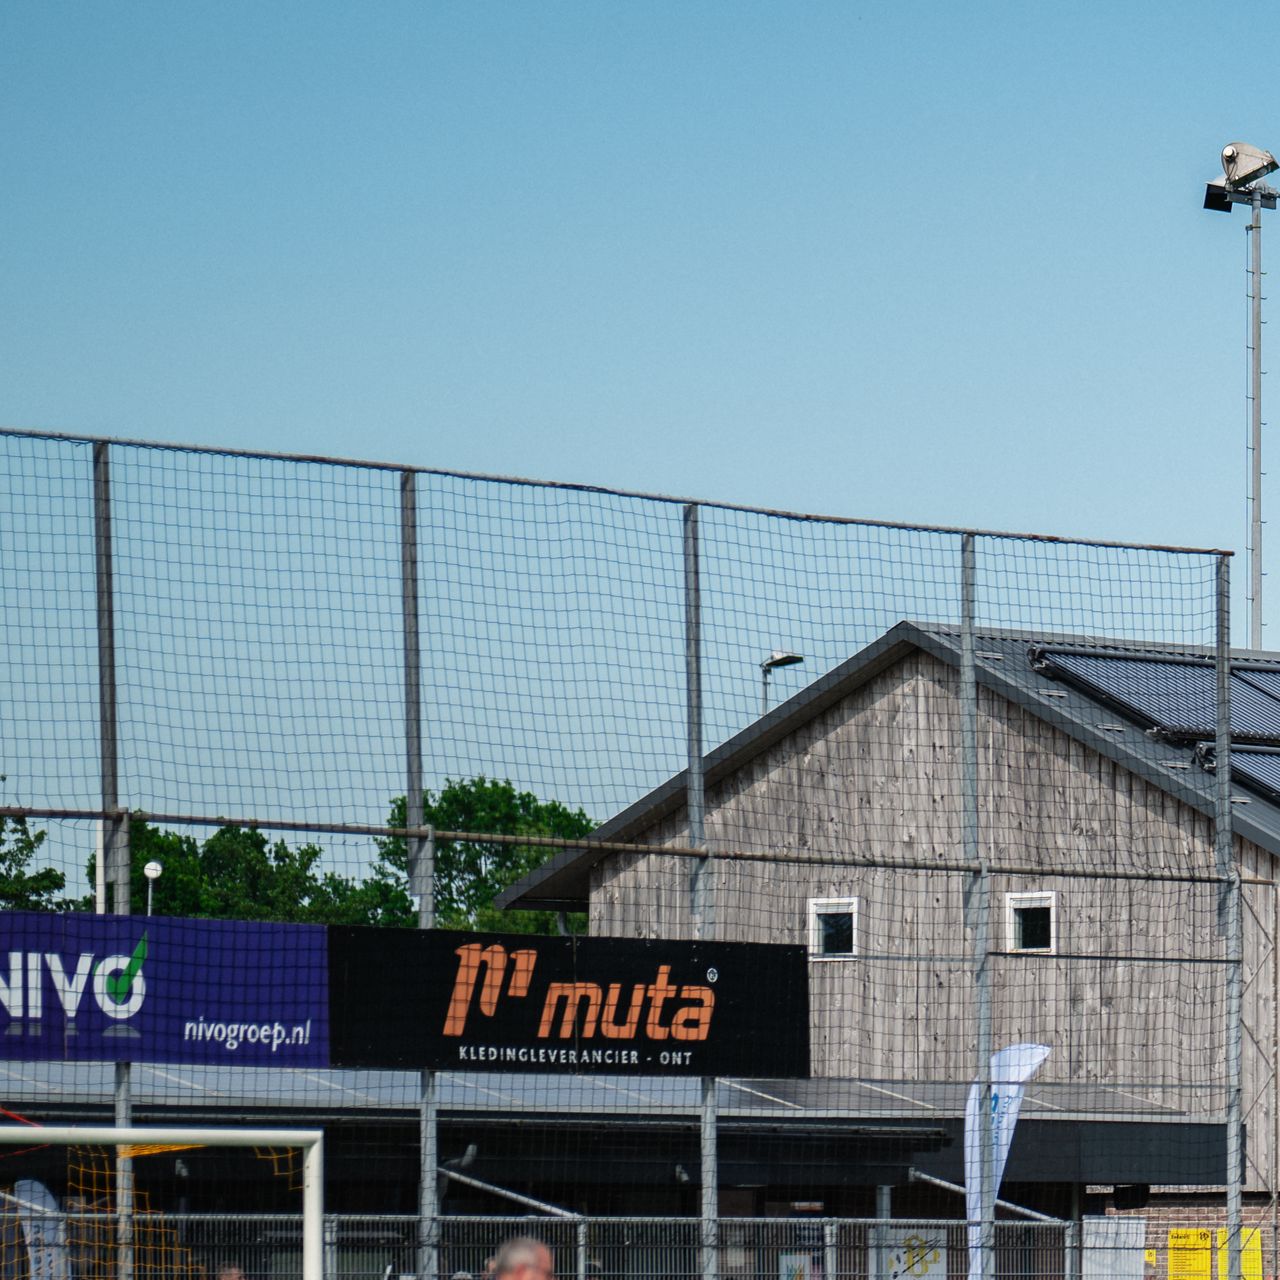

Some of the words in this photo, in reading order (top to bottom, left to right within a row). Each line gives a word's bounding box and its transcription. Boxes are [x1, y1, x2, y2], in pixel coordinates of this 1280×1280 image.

[537, 965, 716, 1041] muta
[184, 1016, 311, 1051] nivogroep.nl
[459, 1046, 639, 1064] KLEDINGLEVERANCIER
[660, 1051, 692, 1065] ONT
